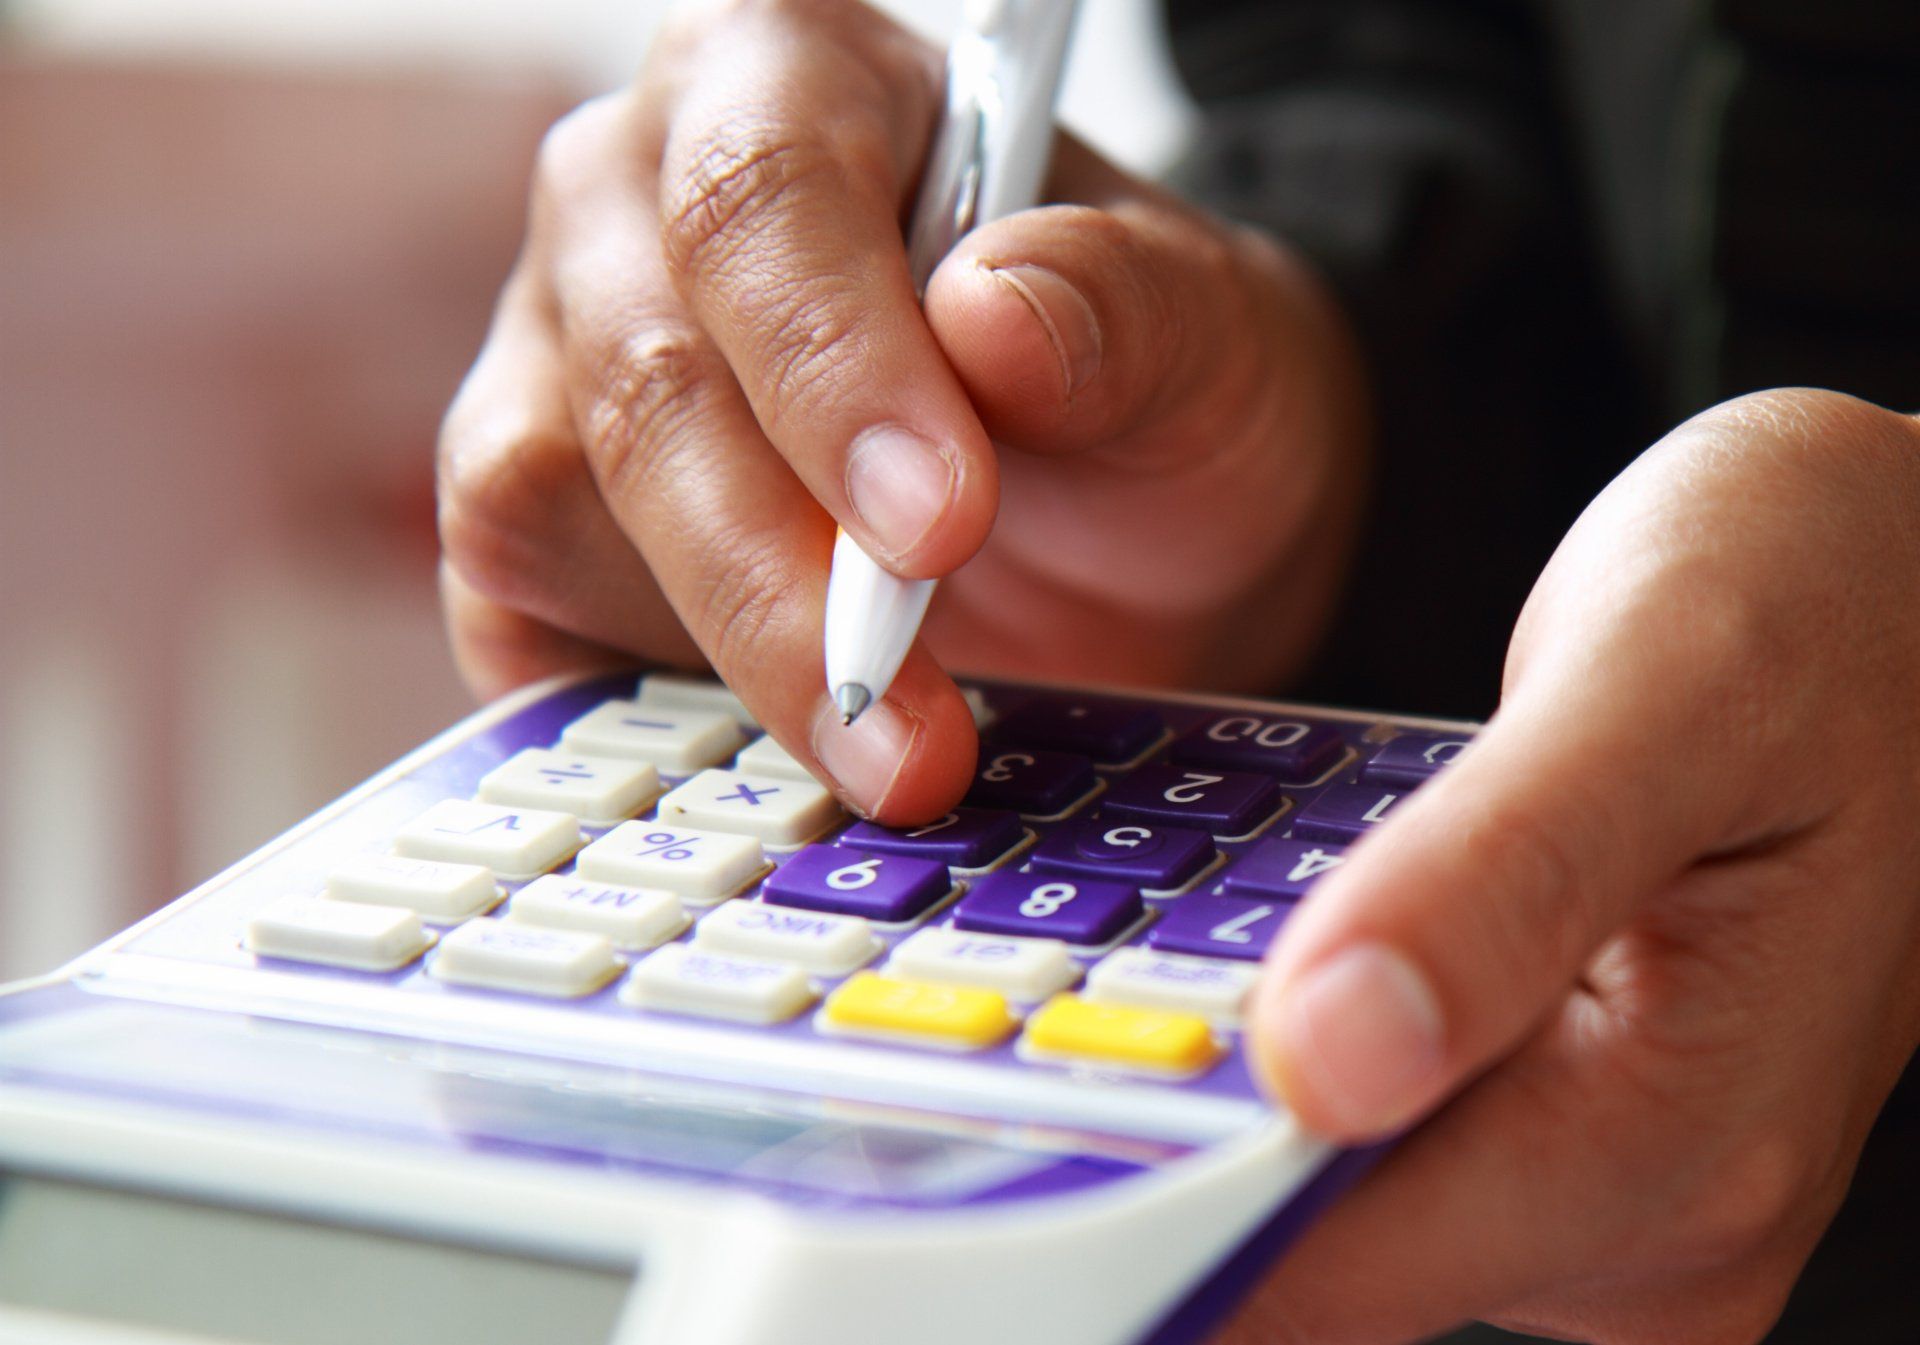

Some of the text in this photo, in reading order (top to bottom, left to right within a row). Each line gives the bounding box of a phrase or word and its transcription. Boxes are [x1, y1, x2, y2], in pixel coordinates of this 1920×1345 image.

[981, 752, 1036, 782] 3
[1162, 772, 1225, 804] 2
[1360, 793, 1399, 824] 1
[636, 831, 701, 862] %
[825, 857, 884, 891] 9
[1286, 848, 1346, 883] 4
[1018, 882, 1078, 918] 8
[1207, 904, 1275, 944] 7
